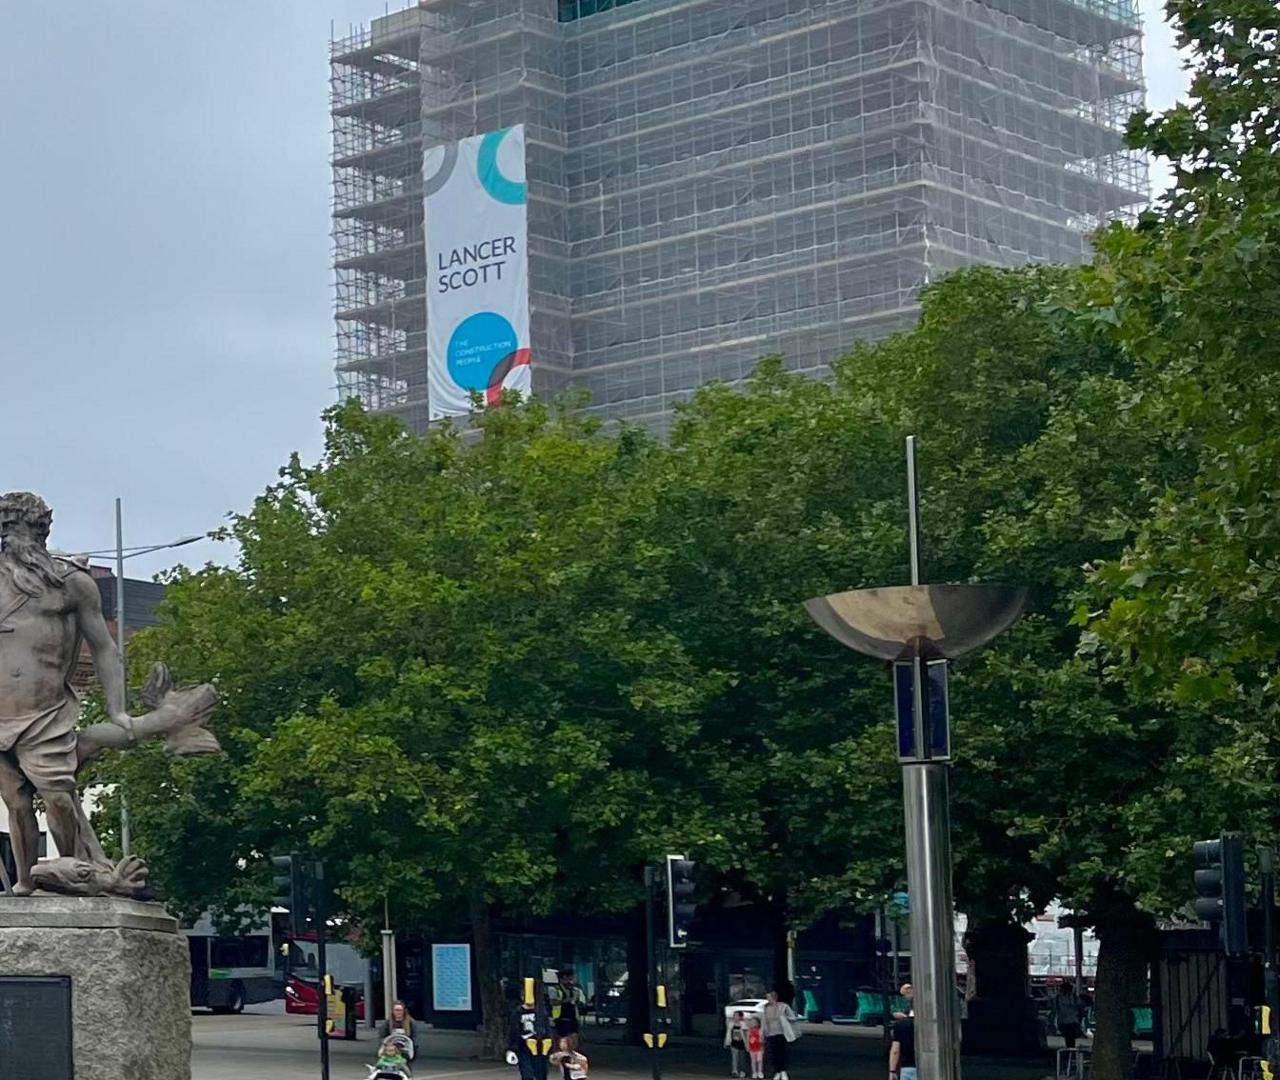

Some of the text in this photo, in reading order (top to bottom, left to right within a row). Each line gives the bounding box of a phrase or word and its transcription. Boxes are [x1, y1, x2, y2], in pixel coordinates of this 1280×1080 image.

[438, 236, 516, 270] LANCER
[438, 261, 506, 293] SCOTT
[455, 341, 512, 357] CONSTRUCTION
